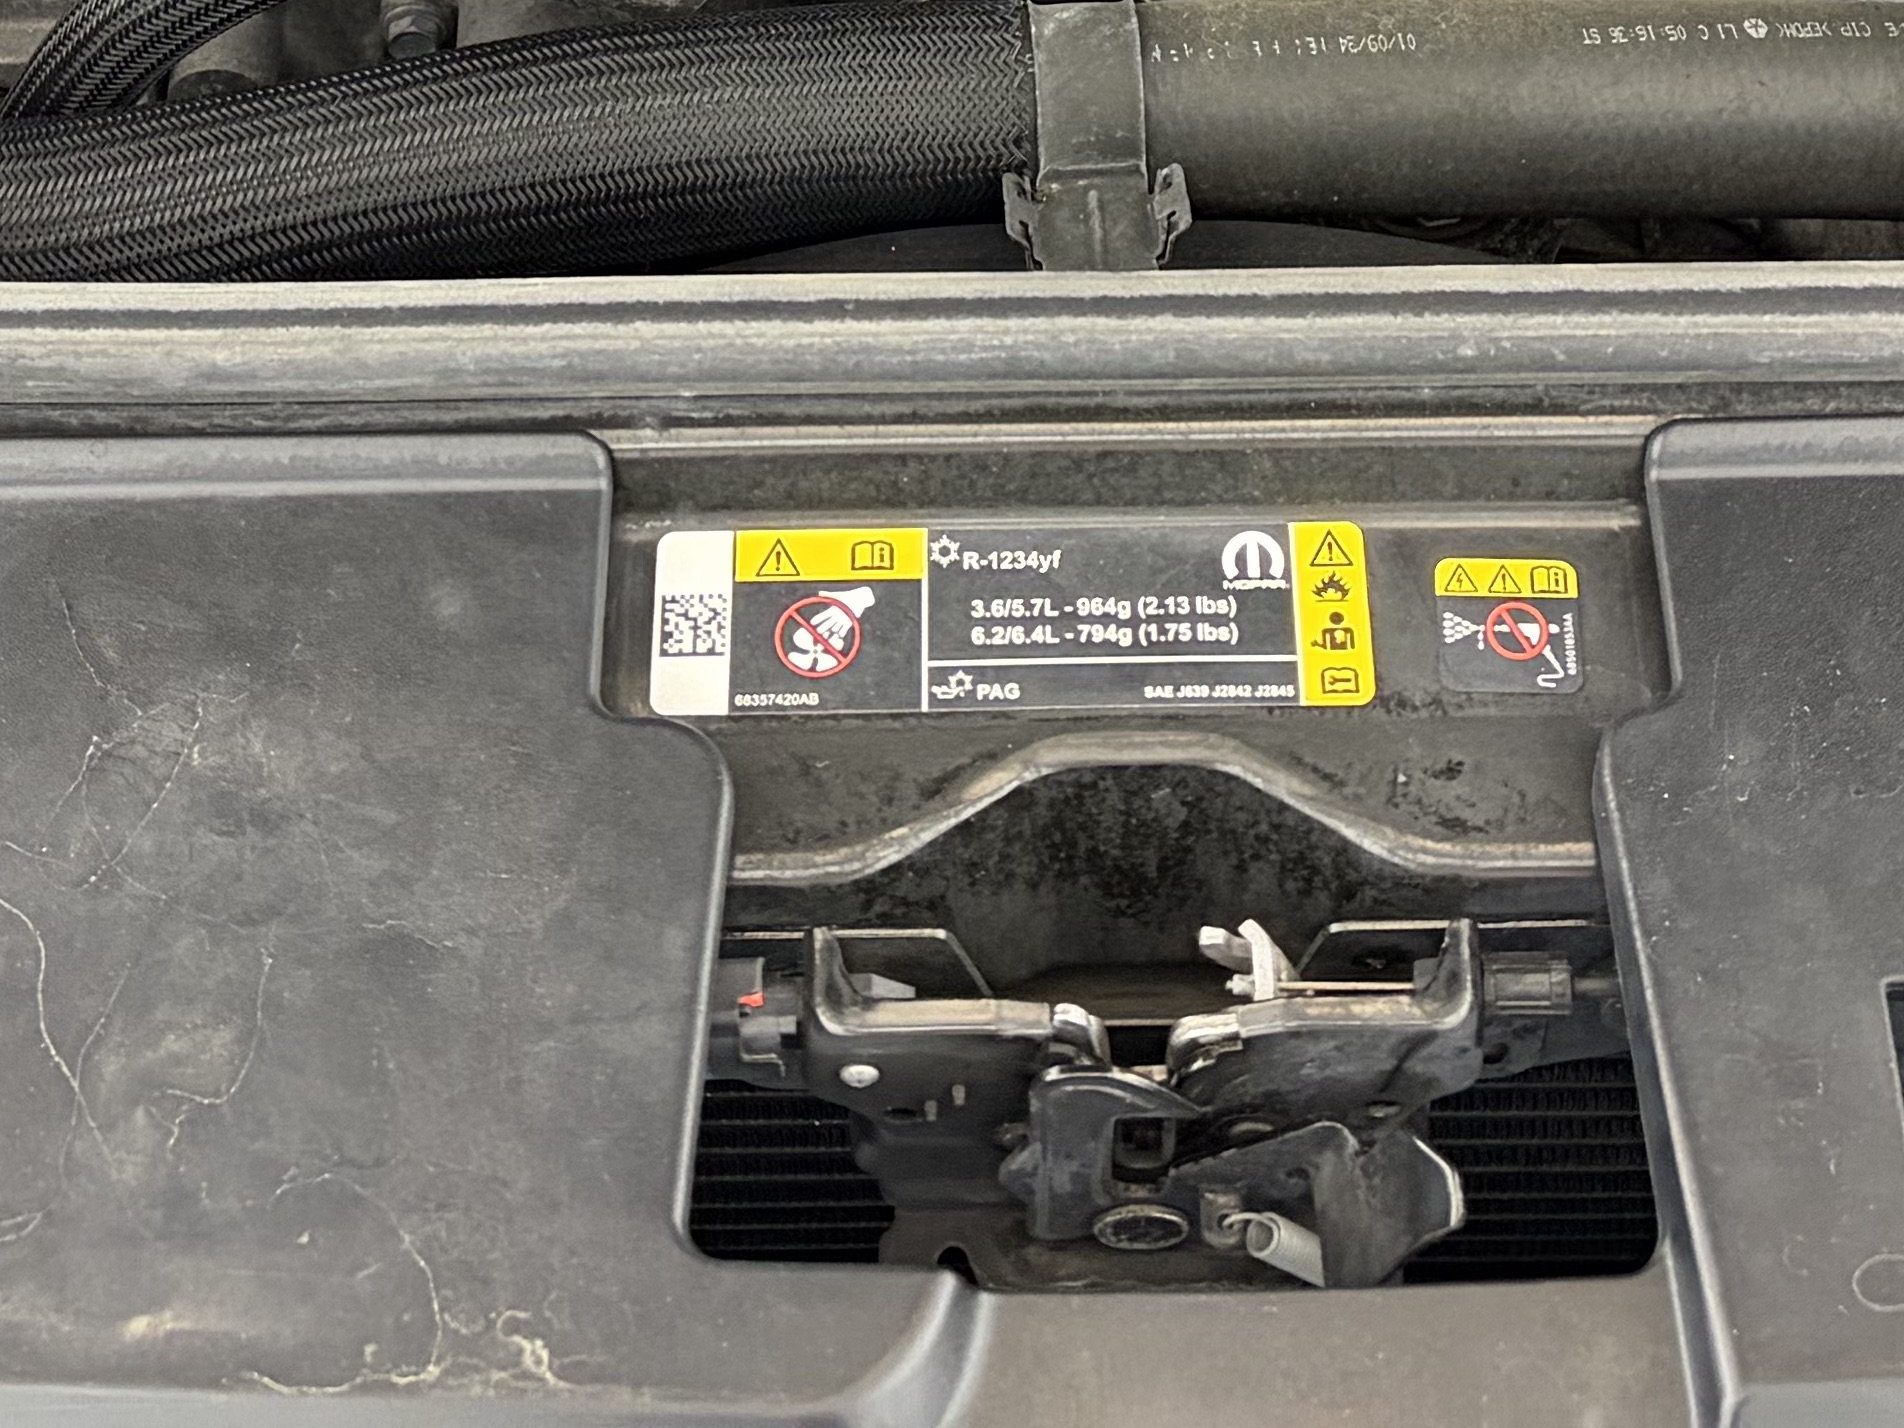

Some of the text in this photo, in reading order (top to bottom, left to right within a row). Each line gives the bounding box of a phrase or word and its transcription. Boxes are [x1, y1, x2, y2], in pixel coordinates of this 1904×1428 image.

[962, 549, 1062, 573] R-1234yf
[971, 598, 1060, 619] 3.6/5.7L
[1076, 597, 1132, 620] 964g
[1138, 595, 1191, 619] (2.13
[1196, 594, 1238, 618] lbs)
[971, 624, 1061, 646] 6.2/6.4L
[1077, 624, 1133, 647] 794g
[1139, 623, 1192, 647] (1.75
[1197, 621, 1239, 645] lbs)
[976, 683, 1020, 701] PAG
[1144, 685, 1174, 699] SAE
